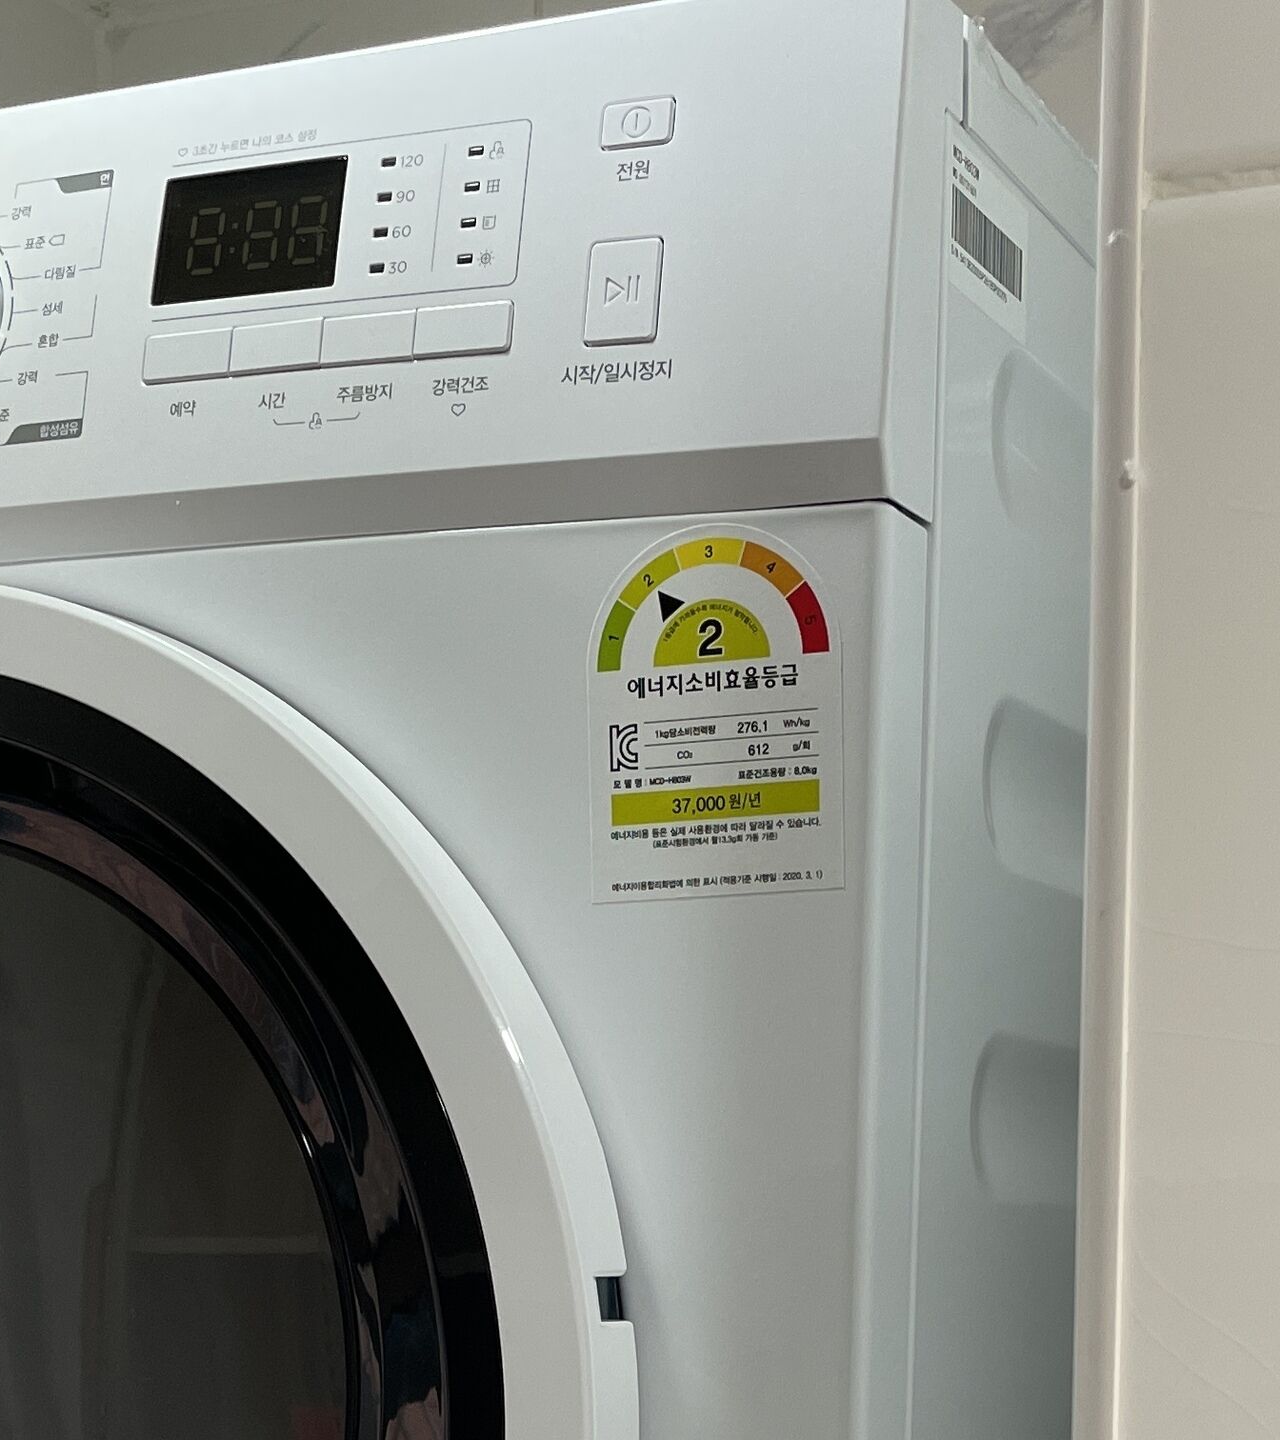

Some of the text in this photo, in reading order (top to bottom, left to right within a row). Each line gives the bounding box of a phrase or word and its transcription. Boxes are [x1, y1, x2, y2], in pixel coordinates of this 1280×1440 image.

[400, 154, 424, 169] 120
[616, 159, 651, 181] 전원
[396, 190, 416, 203] 90
[11, 205, 32, 221] 강력
[392, 224, 412, 238] 60
[24, 236, 46, 250] 표준
[44, 264, 77, 281] 다림질
[388, 261, 408, 274] 30
[41, 300, 64, 316] 섬세
[37, 333, 59, 348] 혼합
[17, 370, 38, 386] 강력
[561, 358, 673, 385] 시작/일시정지
[336, 383, 393, 404] 주름방지
[431, 375, 490, 397] 강력건조
[169, 399, 196, 418] 예약
[258, 392, 286, 410] 시간
[39, 421, 79, 438] 합성섬유
[704, 545, 714, 558] 3
[765, 561, 777, 574] 4
[643, 573, 655, 587] 2
[804, 615, 817, 626] 5
[608, 634, 620, 642] 1
[698, 618, 723, 657] 2
[627, 663, 799, 699] 에너지소비효율등급
[737, 719, 768, 734] 276.1
[783, 716, 811, 728] Wh/kg
[747, 743, 770, 756] 612
[671, 791, 762, 815] 37,000 원/년
[776, 819, 785, 829] 수
